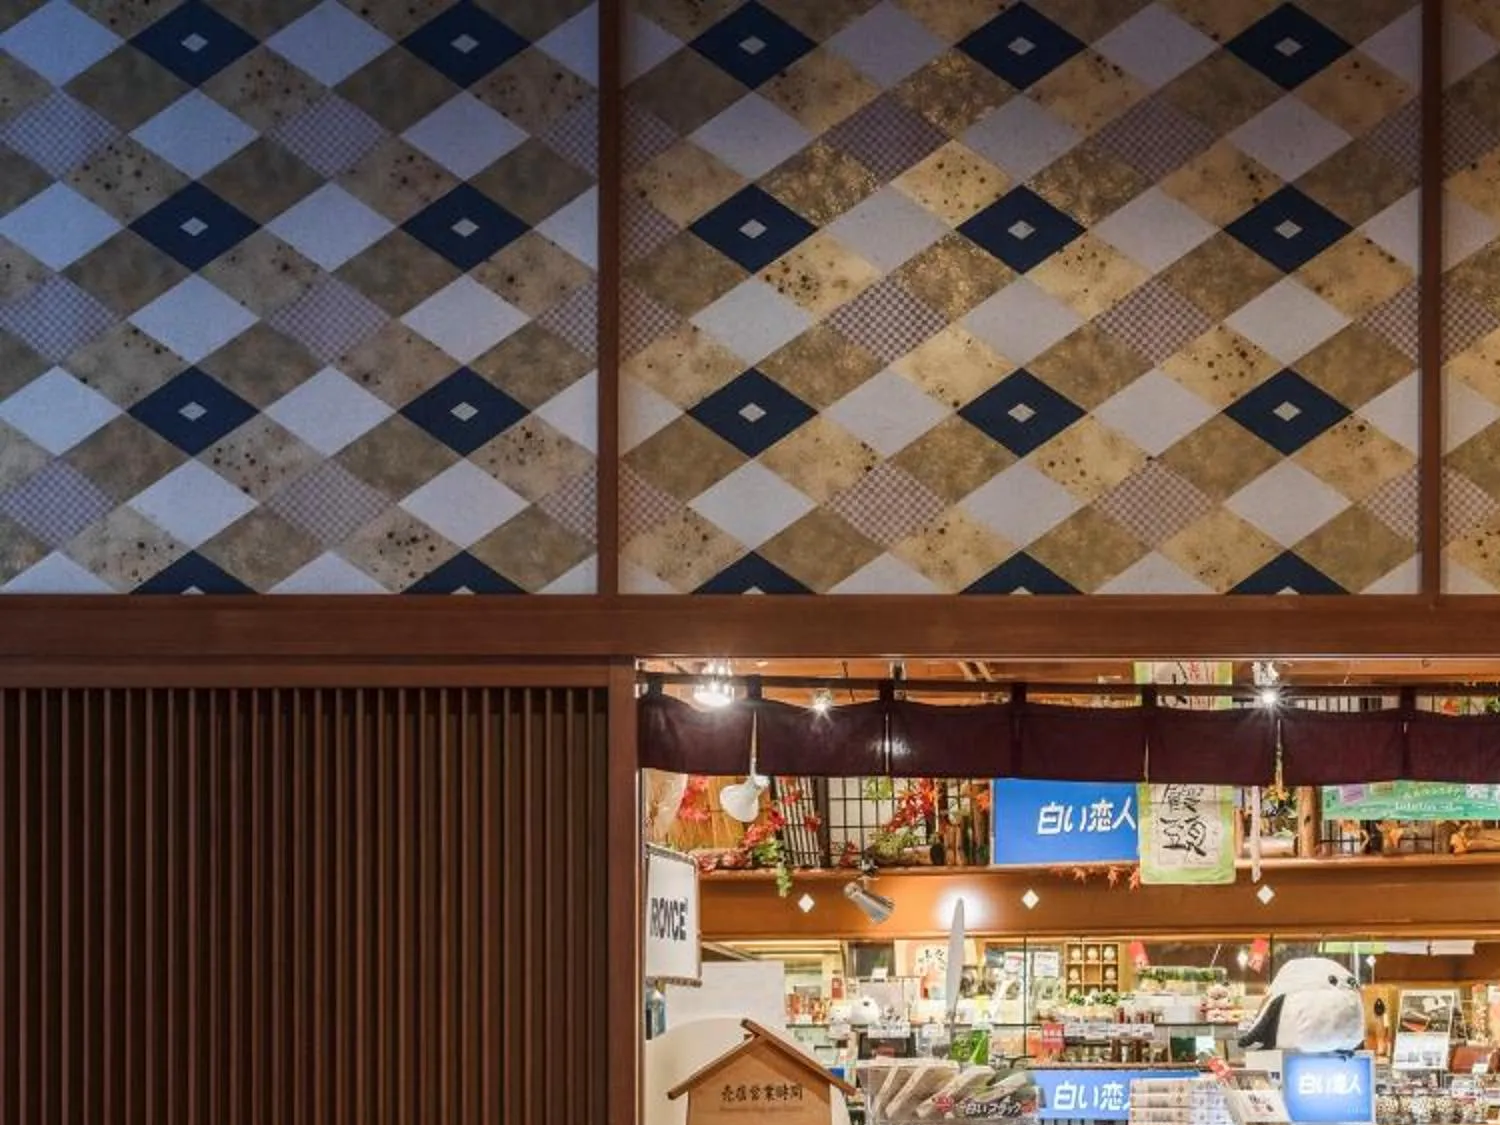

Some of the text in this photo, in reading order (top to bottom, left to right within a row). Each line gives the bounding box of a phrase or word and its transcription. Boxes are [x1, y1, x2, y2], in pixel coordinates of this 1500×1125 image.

[1037, 796, 1138, 835] 白い恋人
[1053, 1081, 1130, 1112] 白い恋
